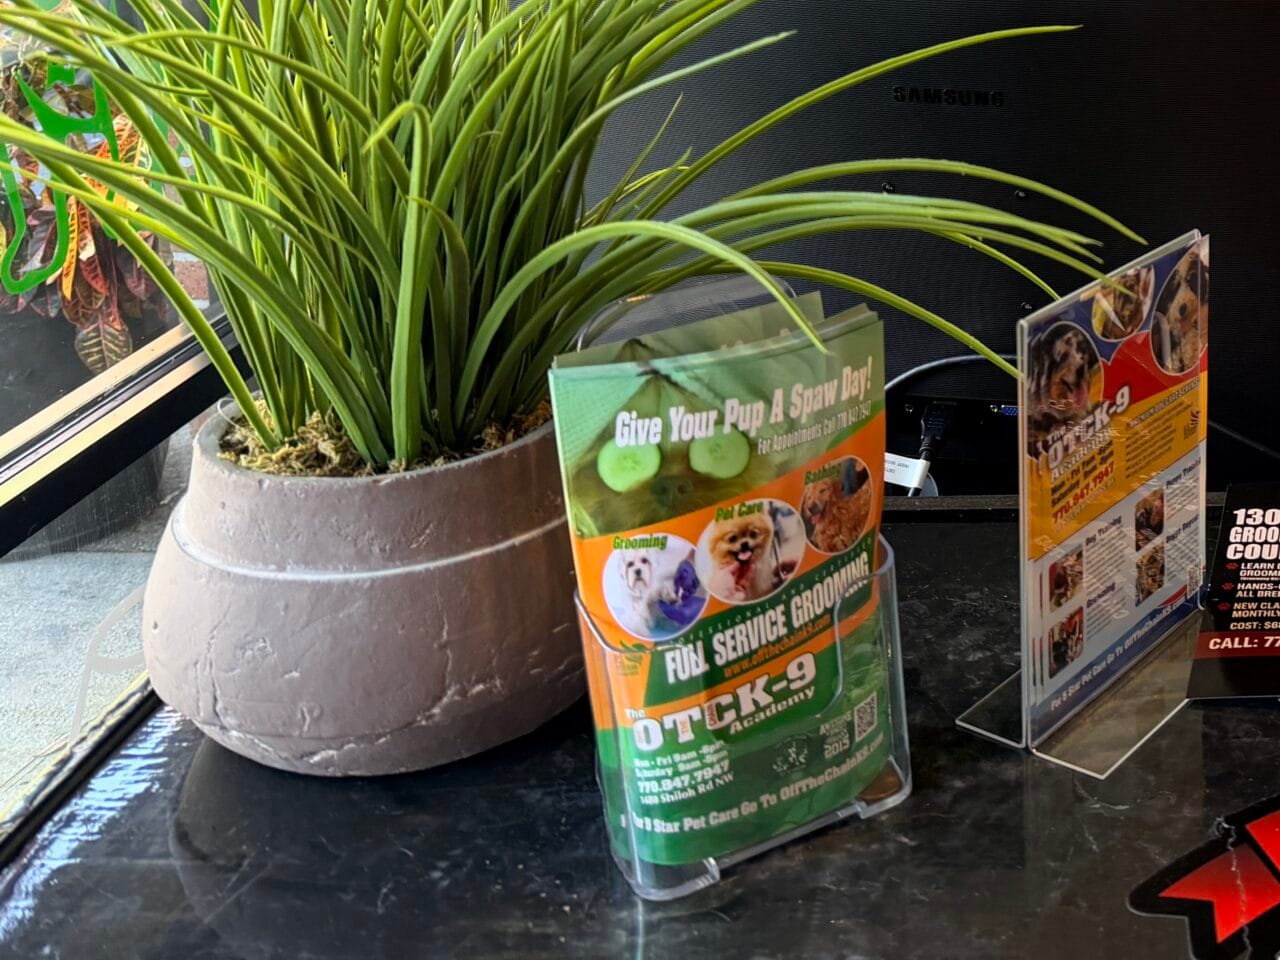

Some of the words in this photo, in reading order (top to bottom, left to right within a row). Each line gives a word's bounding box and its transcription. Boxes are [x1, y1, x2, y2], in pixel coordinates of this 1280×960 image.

[893, 86, 1004, 107] SAMSUNG
[615, 409, 662, 448] Give
[669, 405, 718, 442] Your
[723, 397, 765, 438] Pup
[769, 388, 784, 424] A
[789, 379, 838, 423] Spaw
[840, 356, 873, 401] Day!
[758, 438, 771, 455] For
[773, 423, 822, 452] Appointments
[714, 504, 734, 522] Pet
[736, 501, 764, 518] Care
[612, 533, 668, 551] Grooming
[1233, 602, 1258, 610] NEW
[664, 639, 710, 685] FULL
[712, 603, 788, 667] SERVICE
[790, 551, 869, 629] GROOMING
[1229, 622, 1262, 630] COST:
[1208, 637, 1259, 650] CALL:
[624, 707, 646, 720] The
[729, 685, 816, 736] Academy
[660, 788, 697, 803] Shiloh
[698, 781, 714, 794] Rd
[715, 771, 735, 787] NW
[653, 818, 680, 833] Star
[683, 816, 707, 831] Pet
[709, 807, 740, 825] Care
[740, 801, 758, 816] Go
[759, 793, 778, 809] To
